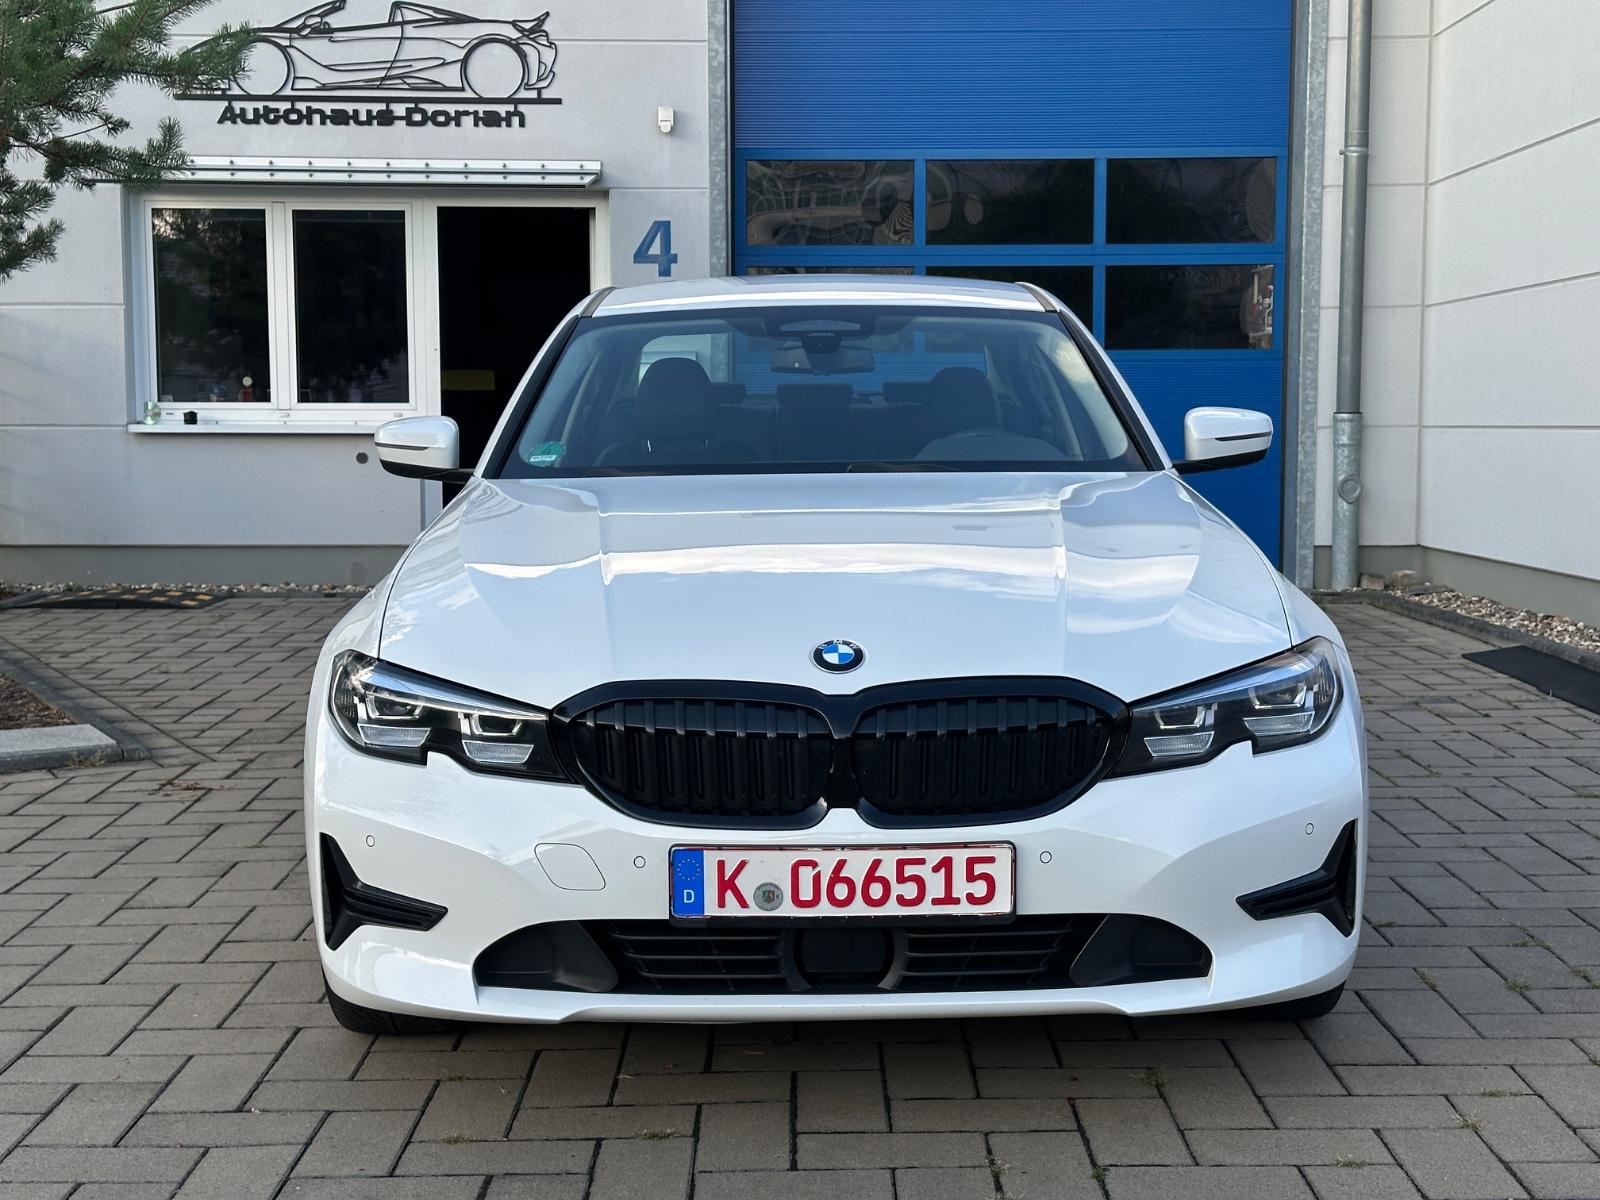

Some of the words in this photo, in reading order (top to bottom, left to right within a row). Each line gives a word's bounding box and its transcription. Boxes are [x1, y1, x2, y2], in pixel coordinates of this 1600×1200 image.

[217, 105, 395, 127] Autohaus
[405, 105, 526, 128] Dorian
[633, 220, 678, 277] 4
[683, 889, 695, 903] D
[716, 858, 750, 909] K
[790, 855, 996, 909] 066515
